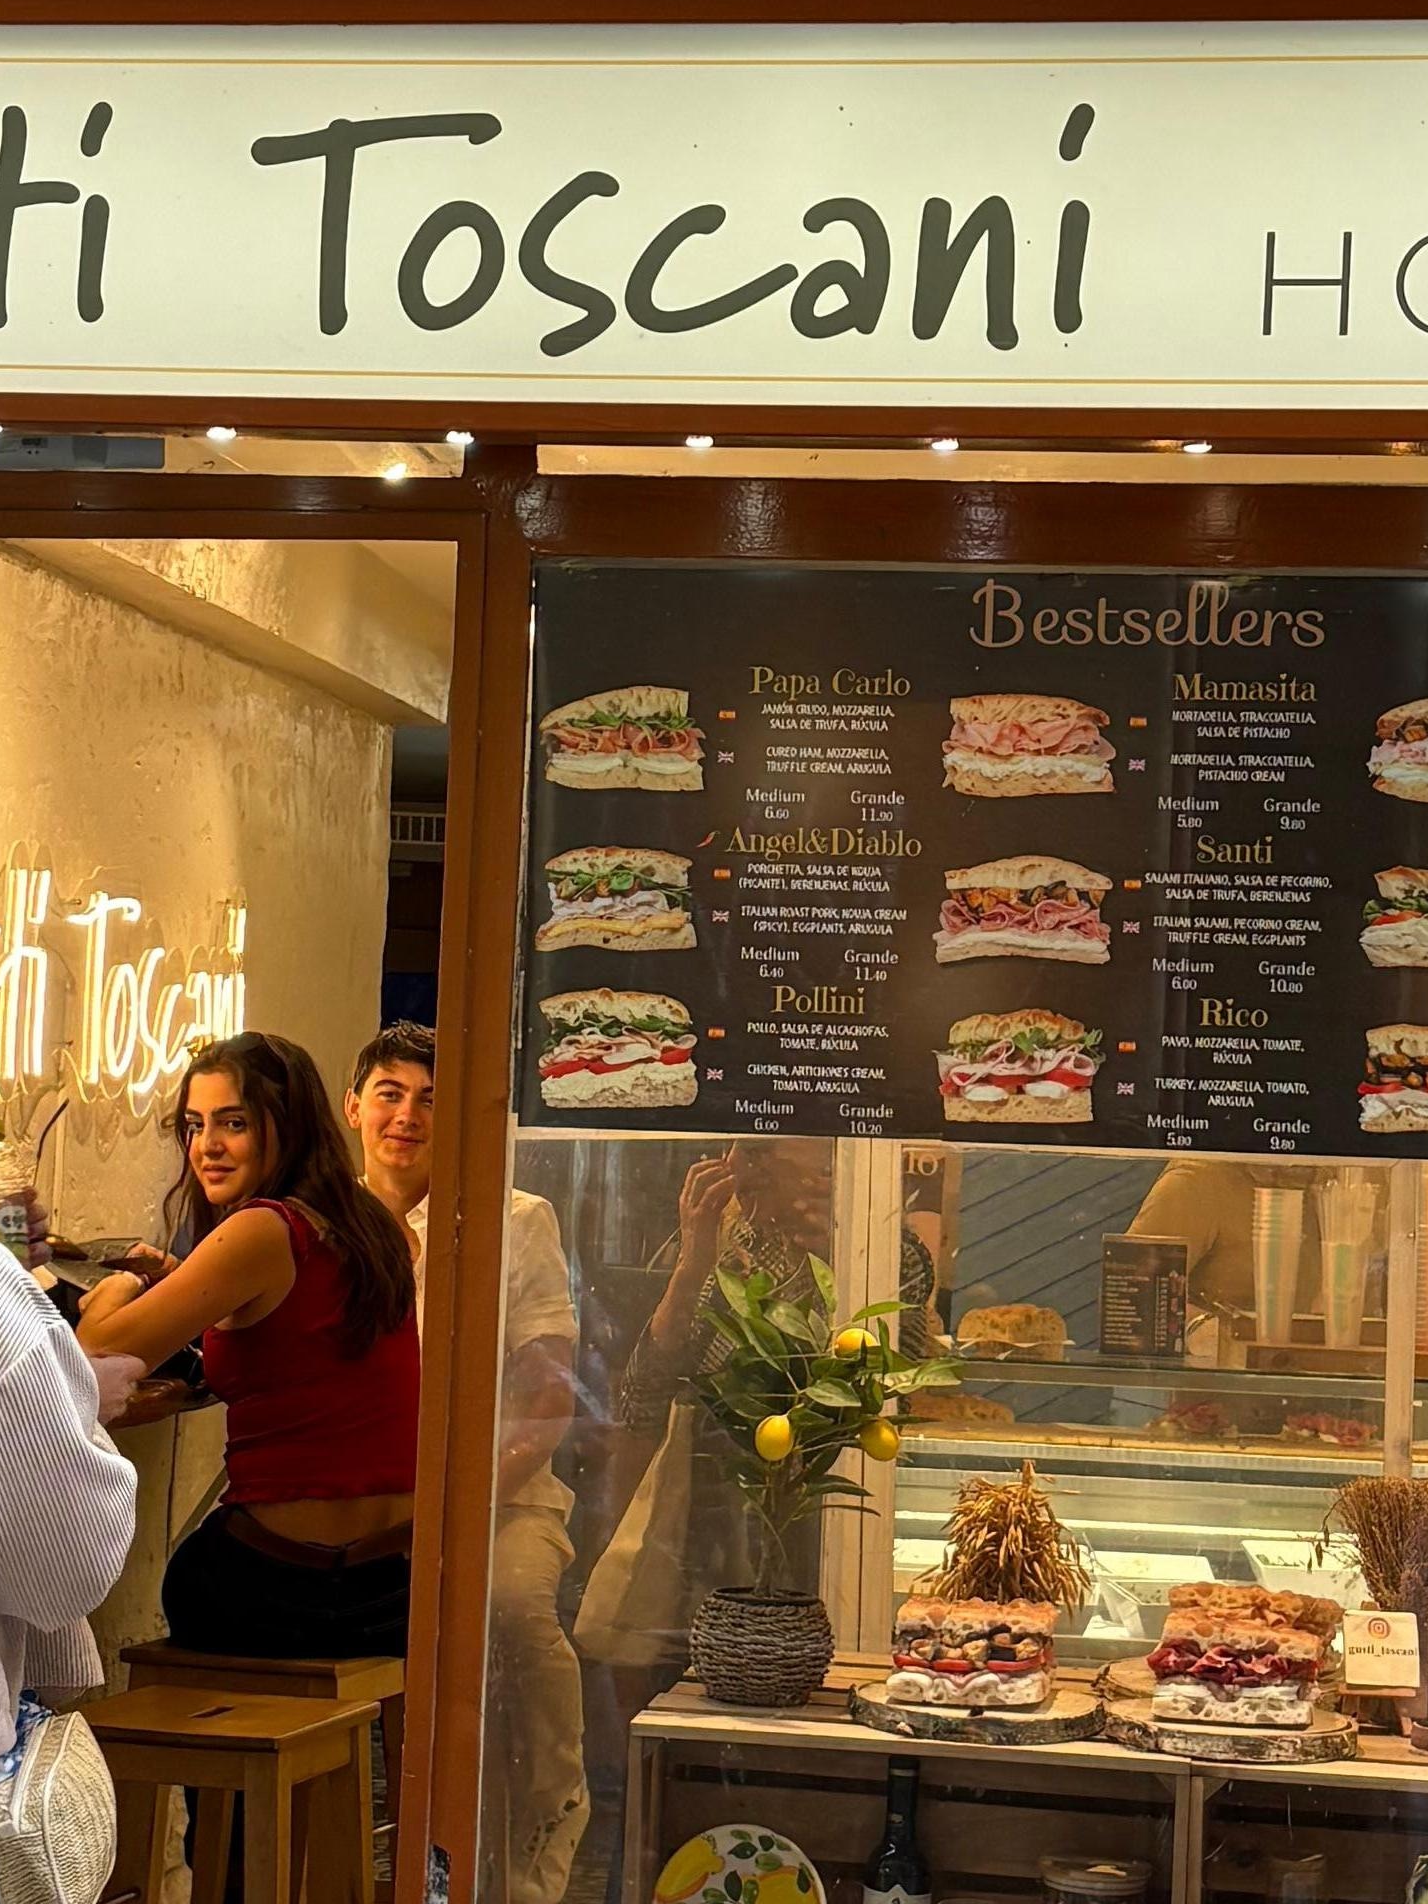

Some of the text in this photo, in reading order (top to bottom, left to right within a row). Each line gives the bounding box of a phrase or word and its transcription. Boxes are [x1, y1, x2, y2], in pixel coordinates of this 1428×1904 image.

[252, 101, 1095, 357] Toscani
[970, 578, 1326, 648] Bestsellers
[749, 666, 911, 701] Papa Carlo
[1173, 673, 1317, 702] Mamasita
[746, 788, 905, 805] Medium Grande
[1158, 797, 1321, 813] Medium Grande
[725, 826, 922, 862] Angel&Diablo
[1196, 835, 1273, 864] Santi
[741, 947, 899, 964] Medium Grande
[1153, 958, 1315, 976] Medium Grande
[771, 986, 865, 1015] Pollini
[1199, 998, 1268, 1027] Rico
[735, 1100, 894, 1118] Medium Grande
[1147, 1115, 1310, 1133] Medium Grande
